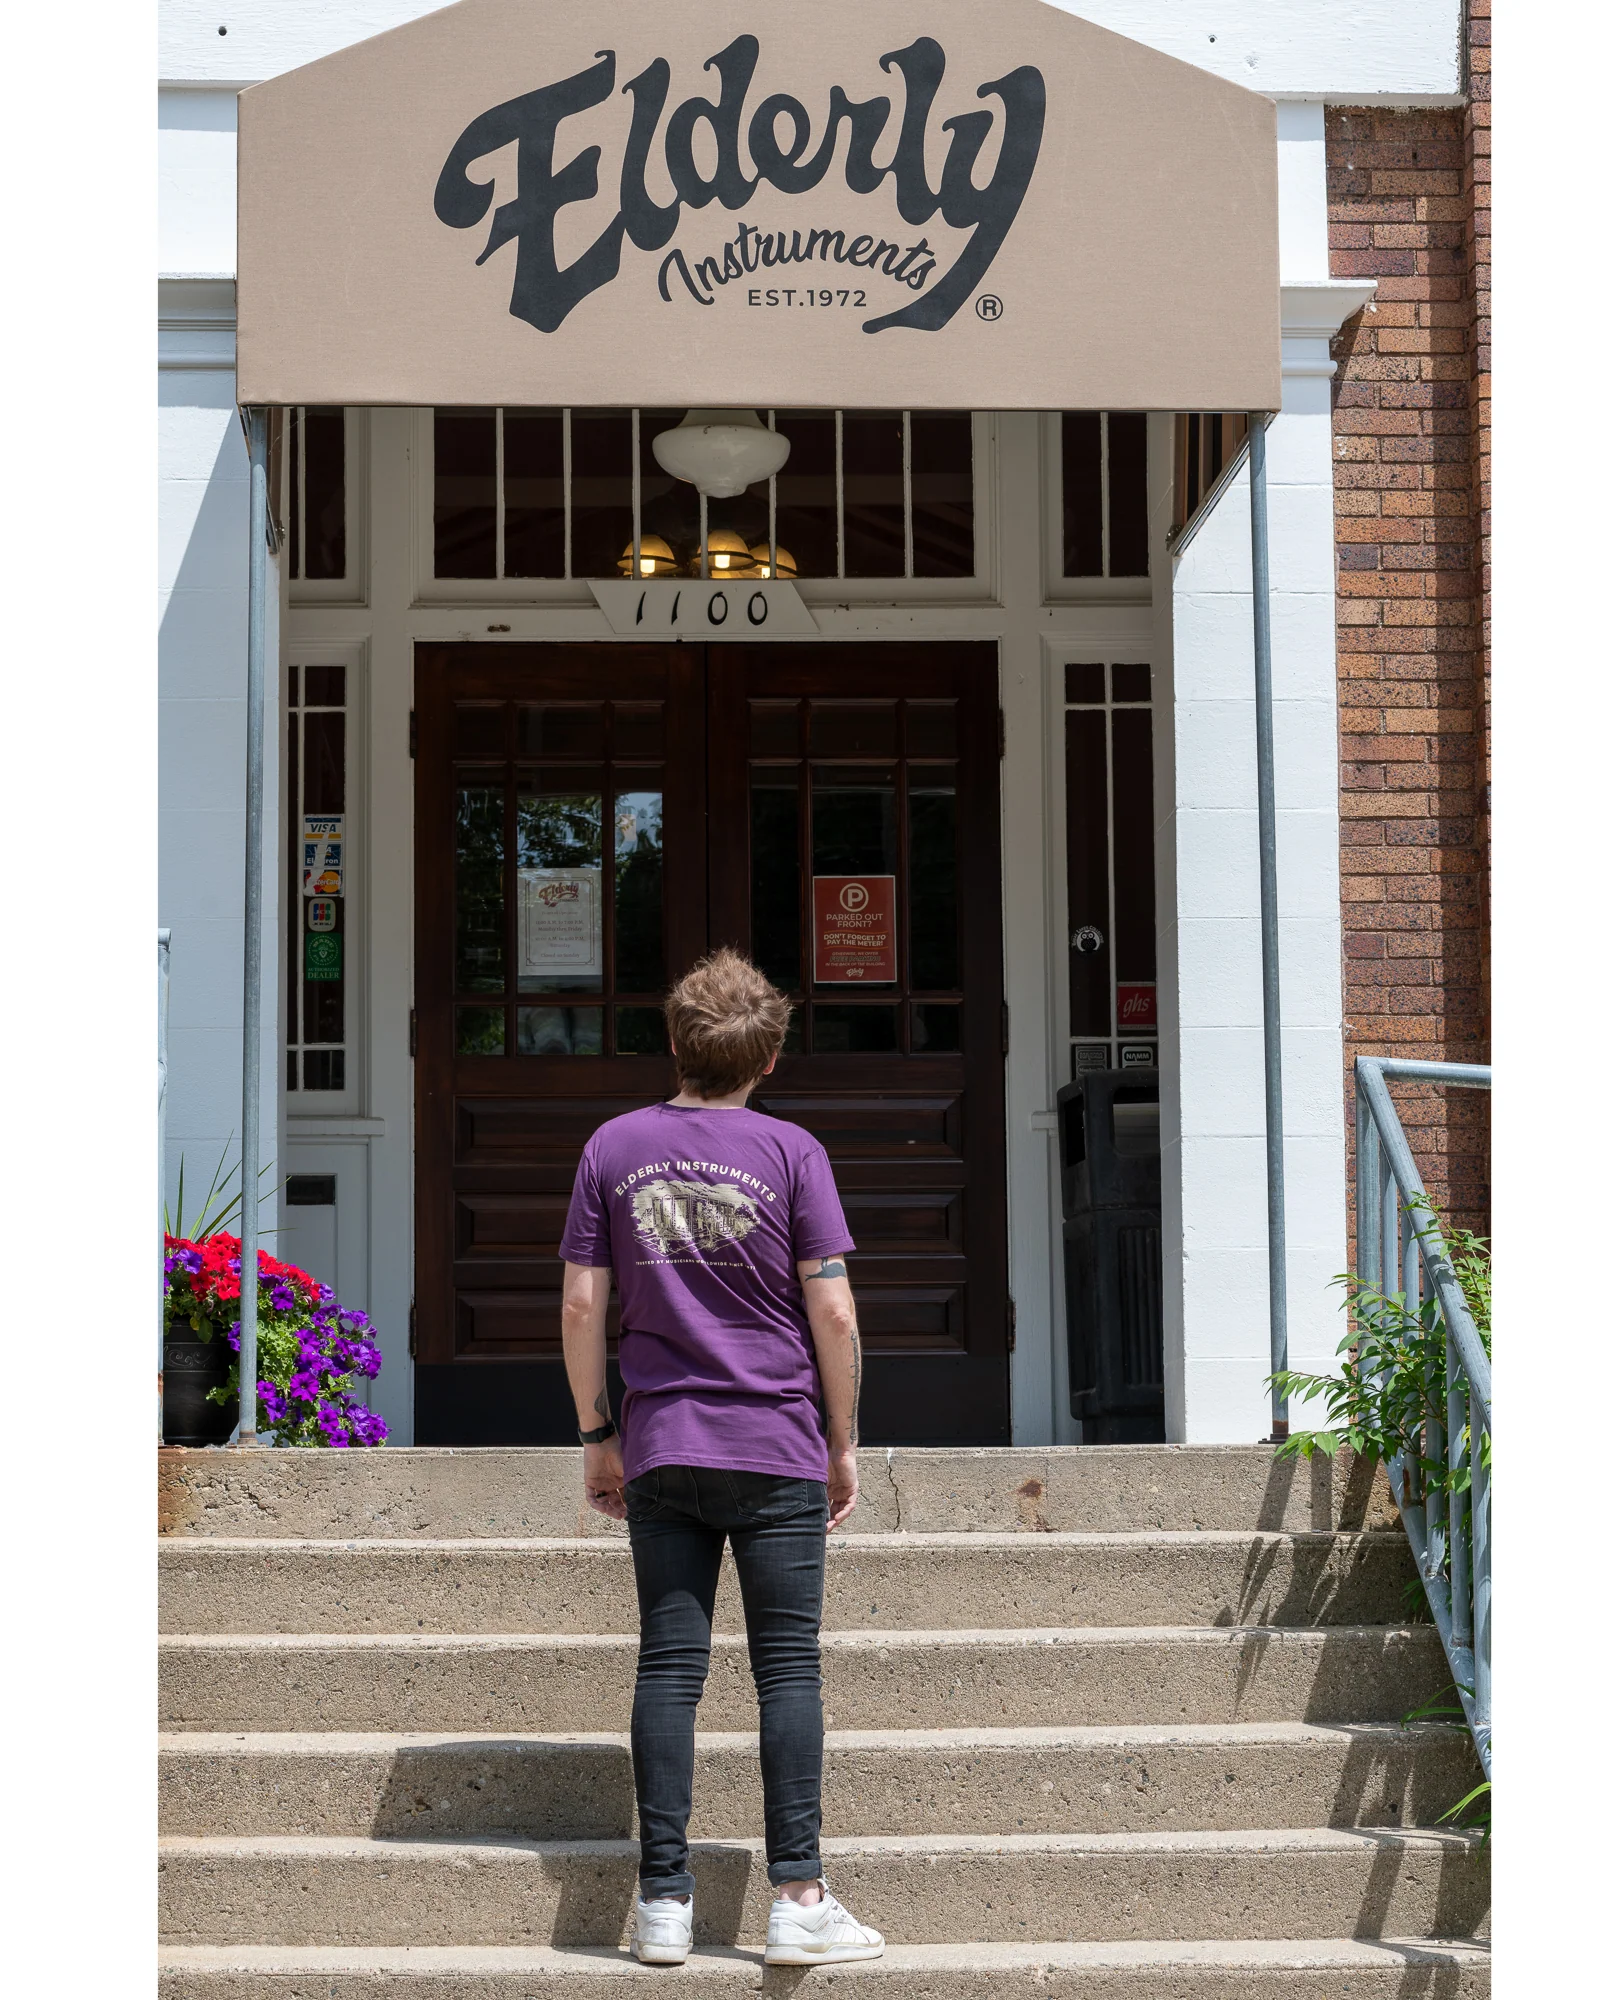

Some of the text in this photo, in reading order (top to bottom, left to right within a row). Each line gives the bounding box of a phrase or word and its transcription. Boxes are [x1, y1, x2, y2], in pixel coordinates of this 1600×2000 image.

[434, 34, 1046, 333] Elderly
[658, 222, 937, 305] Instruments
[748, 289, 867, 307] EST.1972
[636, 591, 768, 625] 1100
[310, 824, 337, 833] VISA
[826, 913, 884, 921] PARKED OUT
[837, 920, 872, 928] FRONT?
[823, 933, 846, 941] DON'T
[307, 971, 340, 979] DEALER
[1122, 992, 1151, 1018] ghs
[1126, 1053, 1150, 1062] NAMM
[615, 1161, 777, 1202] ELDERLY INSTRUMENTS
